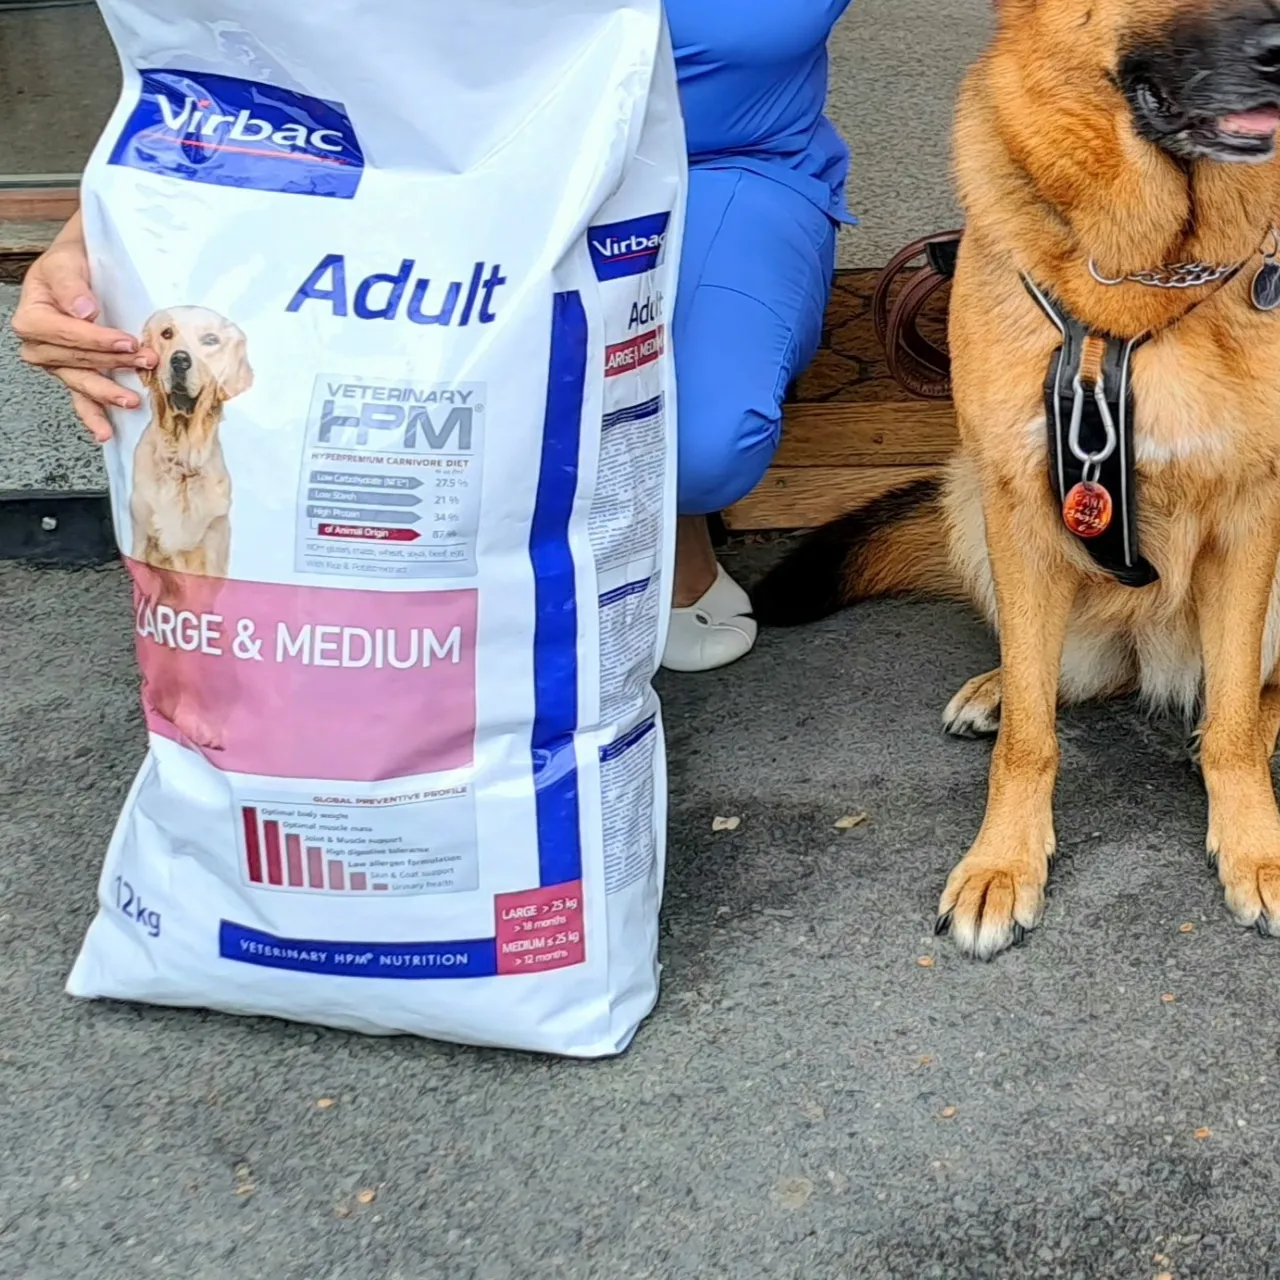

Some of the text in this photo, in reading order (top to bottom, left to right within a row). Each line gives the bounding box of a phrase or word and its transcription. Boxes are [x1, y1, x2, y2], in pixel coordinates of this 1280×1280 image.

[155, 93, 344, 153] Virbac
[592, 231, 667, 258] Virbac
[286, 253, 506, 328] Adult
[326, 381, 474, 405] VETERINARY
[311, 452, 470, 468] HYPERPREMIUM CARNIVORE DIET
[434, 495, 446, 505] 21
[334, 526, 363, 536] Animal
[364, 528, 389, 539] Origin
[136, 596, 462, 670] LARGE & MEDIUM
[312, 786, 468, 805] GLOBAL PREVENTIVE PROFILE
[112, 875, 162, 939] 12kg
[502, 905, 538, 920] LARGE
[551, 900, 564, 912] 25
[565, 898, 578, 910] kg
[522, 921, 533, 931] 18
[534, 914, 567, 930] months
[239, 938, 328, 963] VETERINARY
[379, 951, 469, 967] NUTRITION
[502, 936, 545, 954] MEDIUM
[555, 932, 567, 944] 25
[567, 930, 580, 944] kg
[523, 953, 534, 965] 12
[535, 949, 568, 963] months
